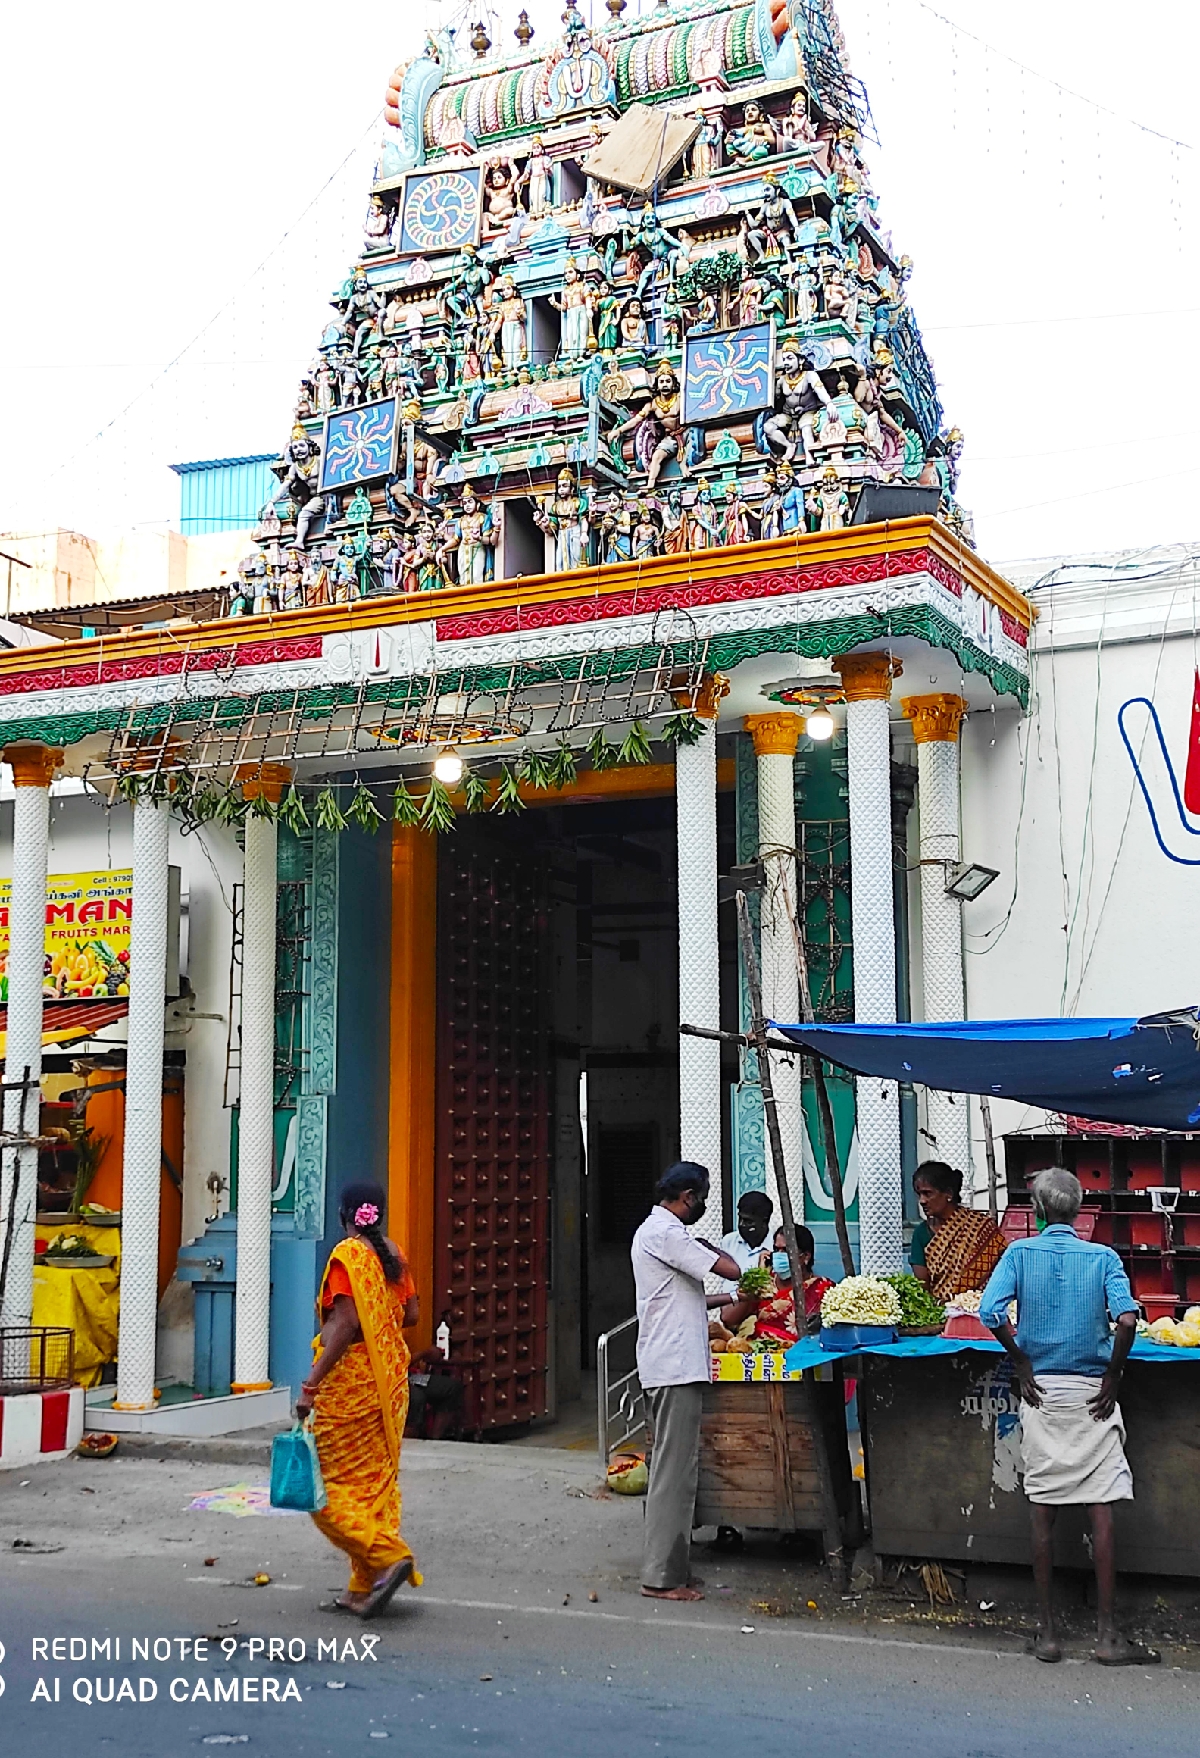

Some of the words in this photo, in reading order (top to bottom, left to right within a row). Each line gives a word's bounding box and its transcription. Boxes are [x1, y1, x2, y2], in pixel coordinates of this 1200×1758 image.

[86, 886, 132, 897] அங்கா
[45, 898, 132, 925] MAN
[52, 928, 97, 939] FRUITS
[103, 926, 131, 936] MAR
